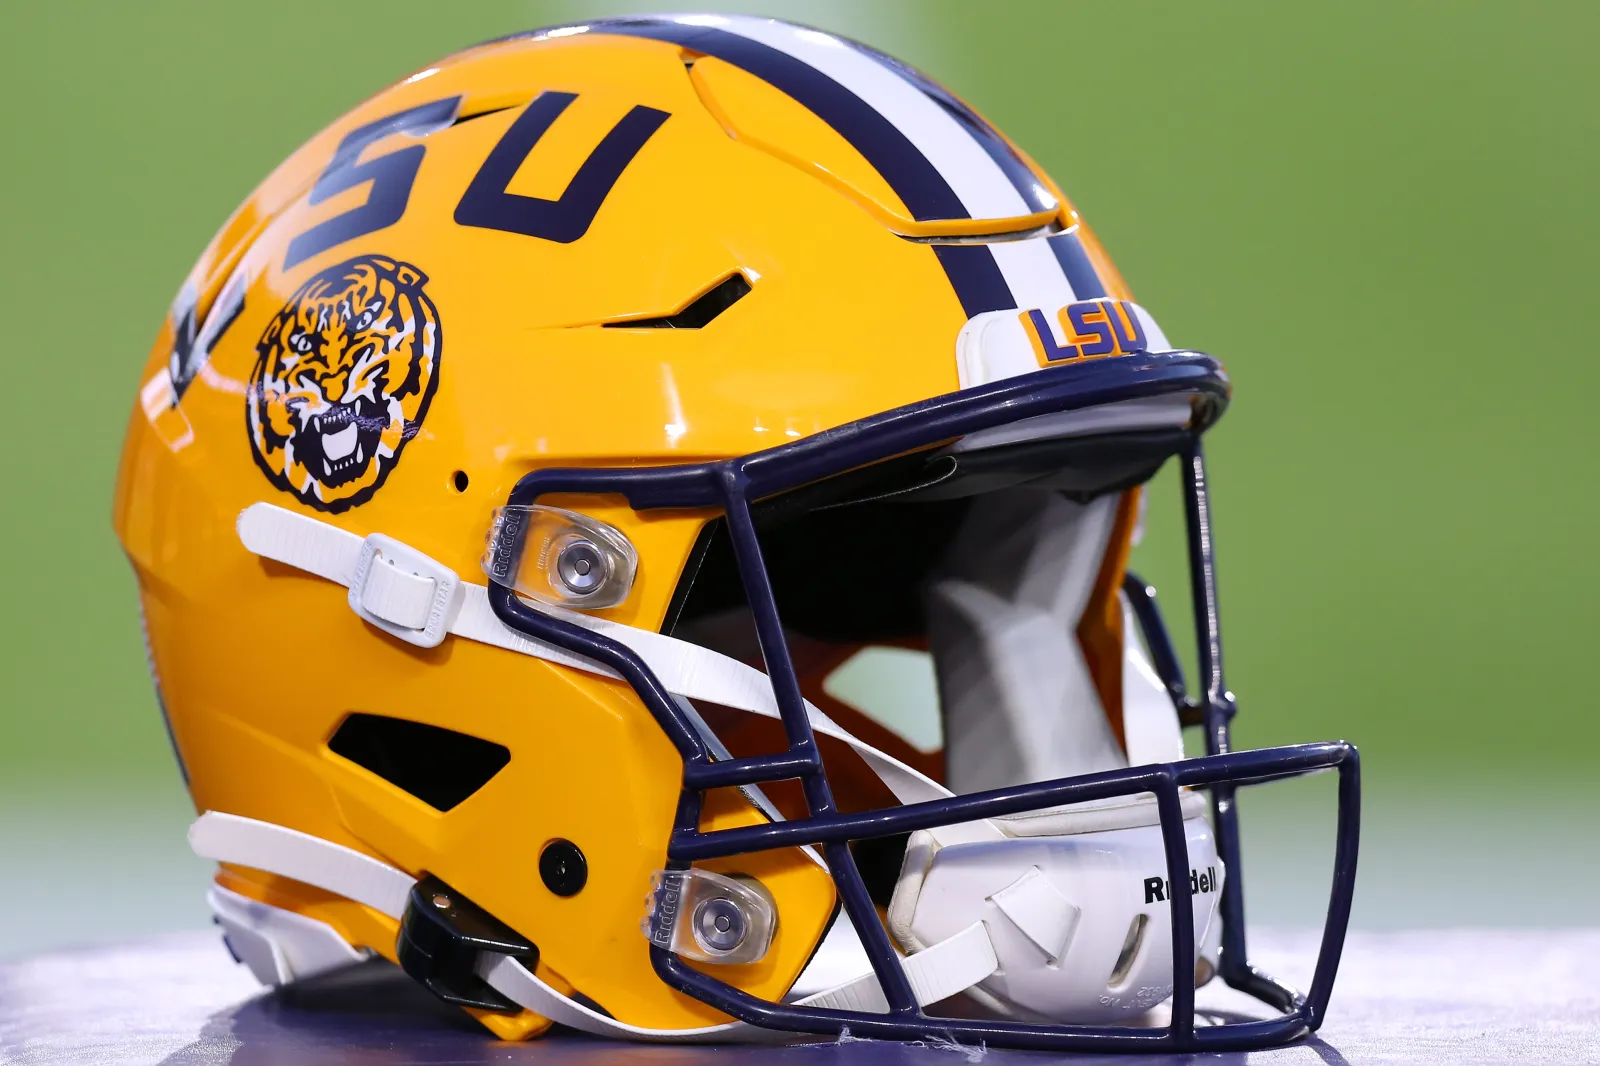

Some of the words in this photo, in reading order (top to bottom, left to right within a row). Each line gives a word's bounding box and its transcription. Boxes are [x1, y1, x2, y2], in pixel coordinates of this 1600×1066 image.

[1018, 301, 1148, 368] LSU
[492, 513, 521, 577] Riddell
[654, 879, 681, 944] Riddell
[1144, 866, 1217, 904] Ridell
